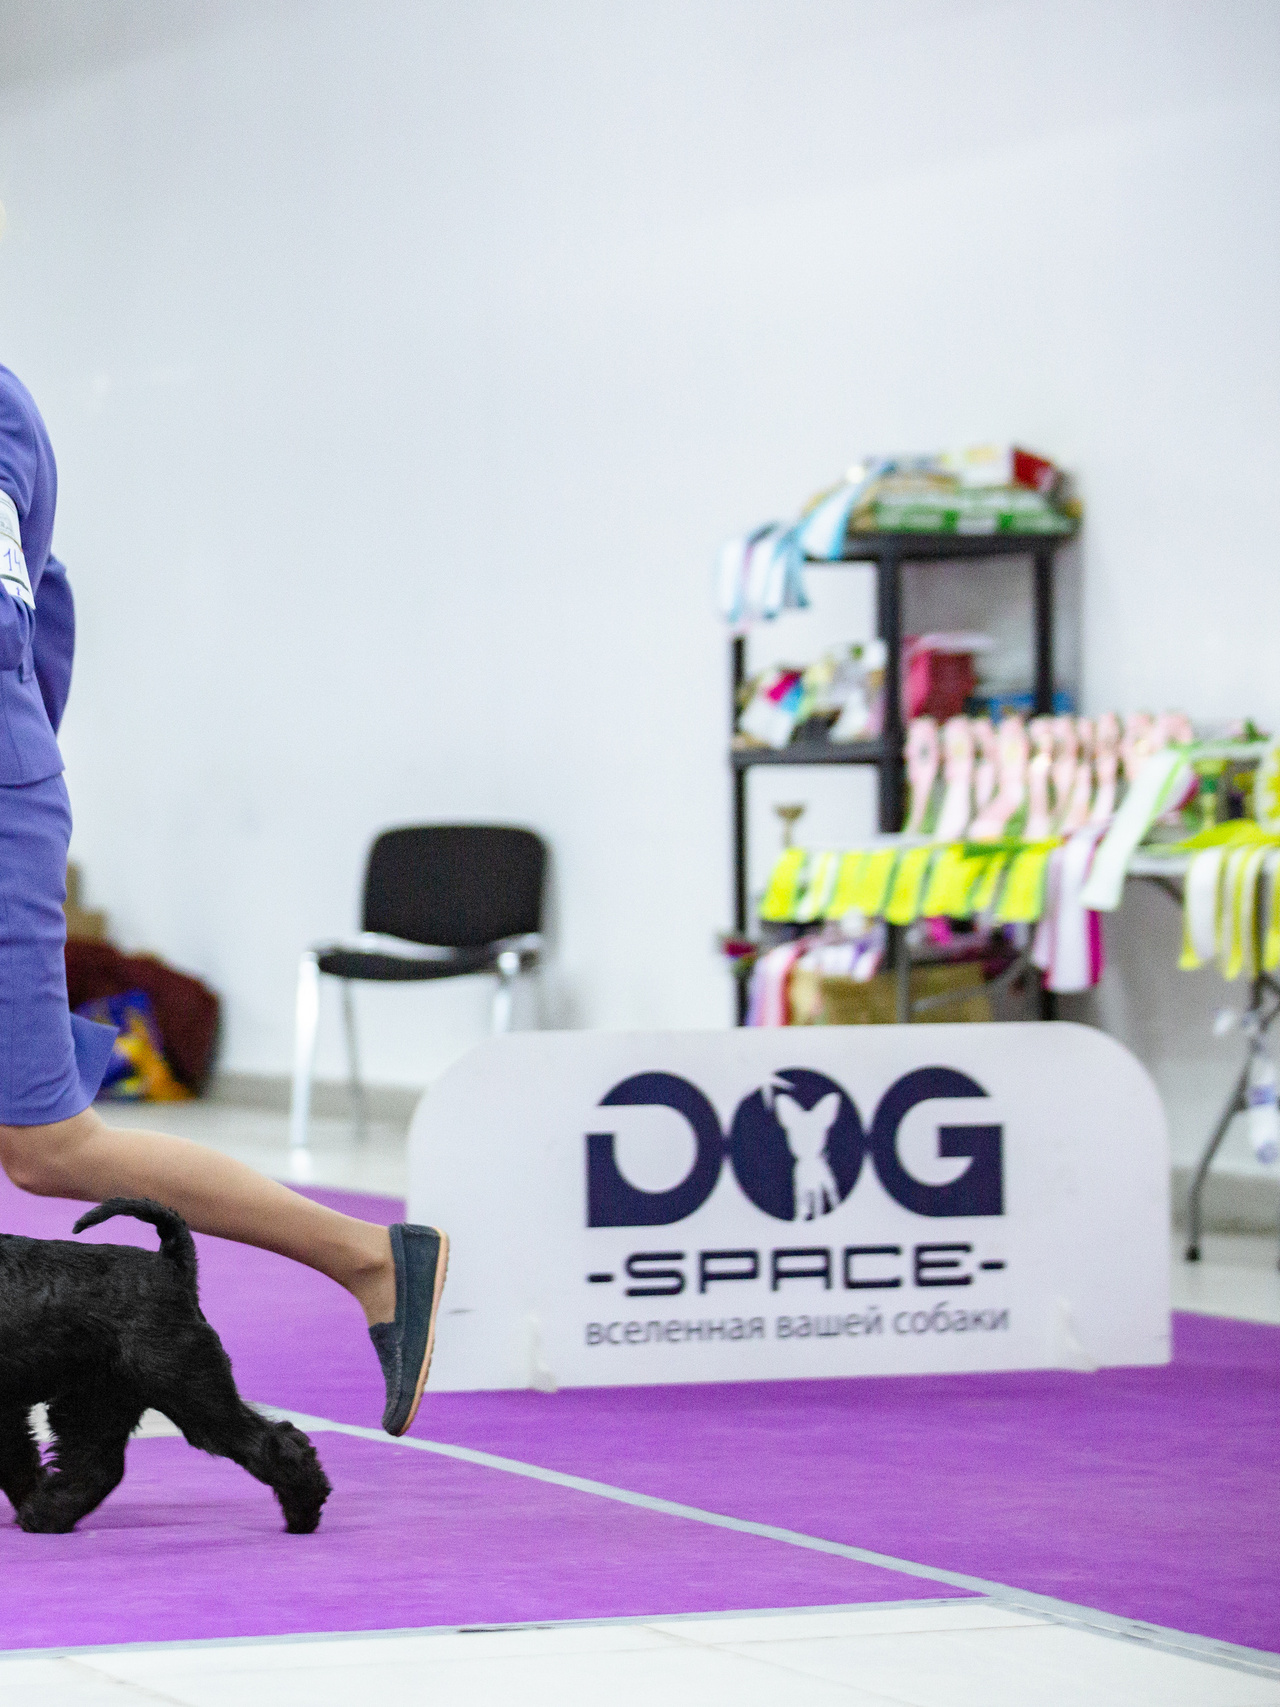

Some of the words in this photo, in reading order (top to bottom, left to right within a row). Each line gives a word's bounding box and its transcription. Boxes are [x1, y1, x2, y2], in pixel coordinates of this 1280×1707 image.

[585, 1065, 1006, 1228] DOG
[584, 1316, 766, 1347] вселенная
[775, 1305, 885, 1339] вашей
[893, 1301, 1011, 1336] собаки
